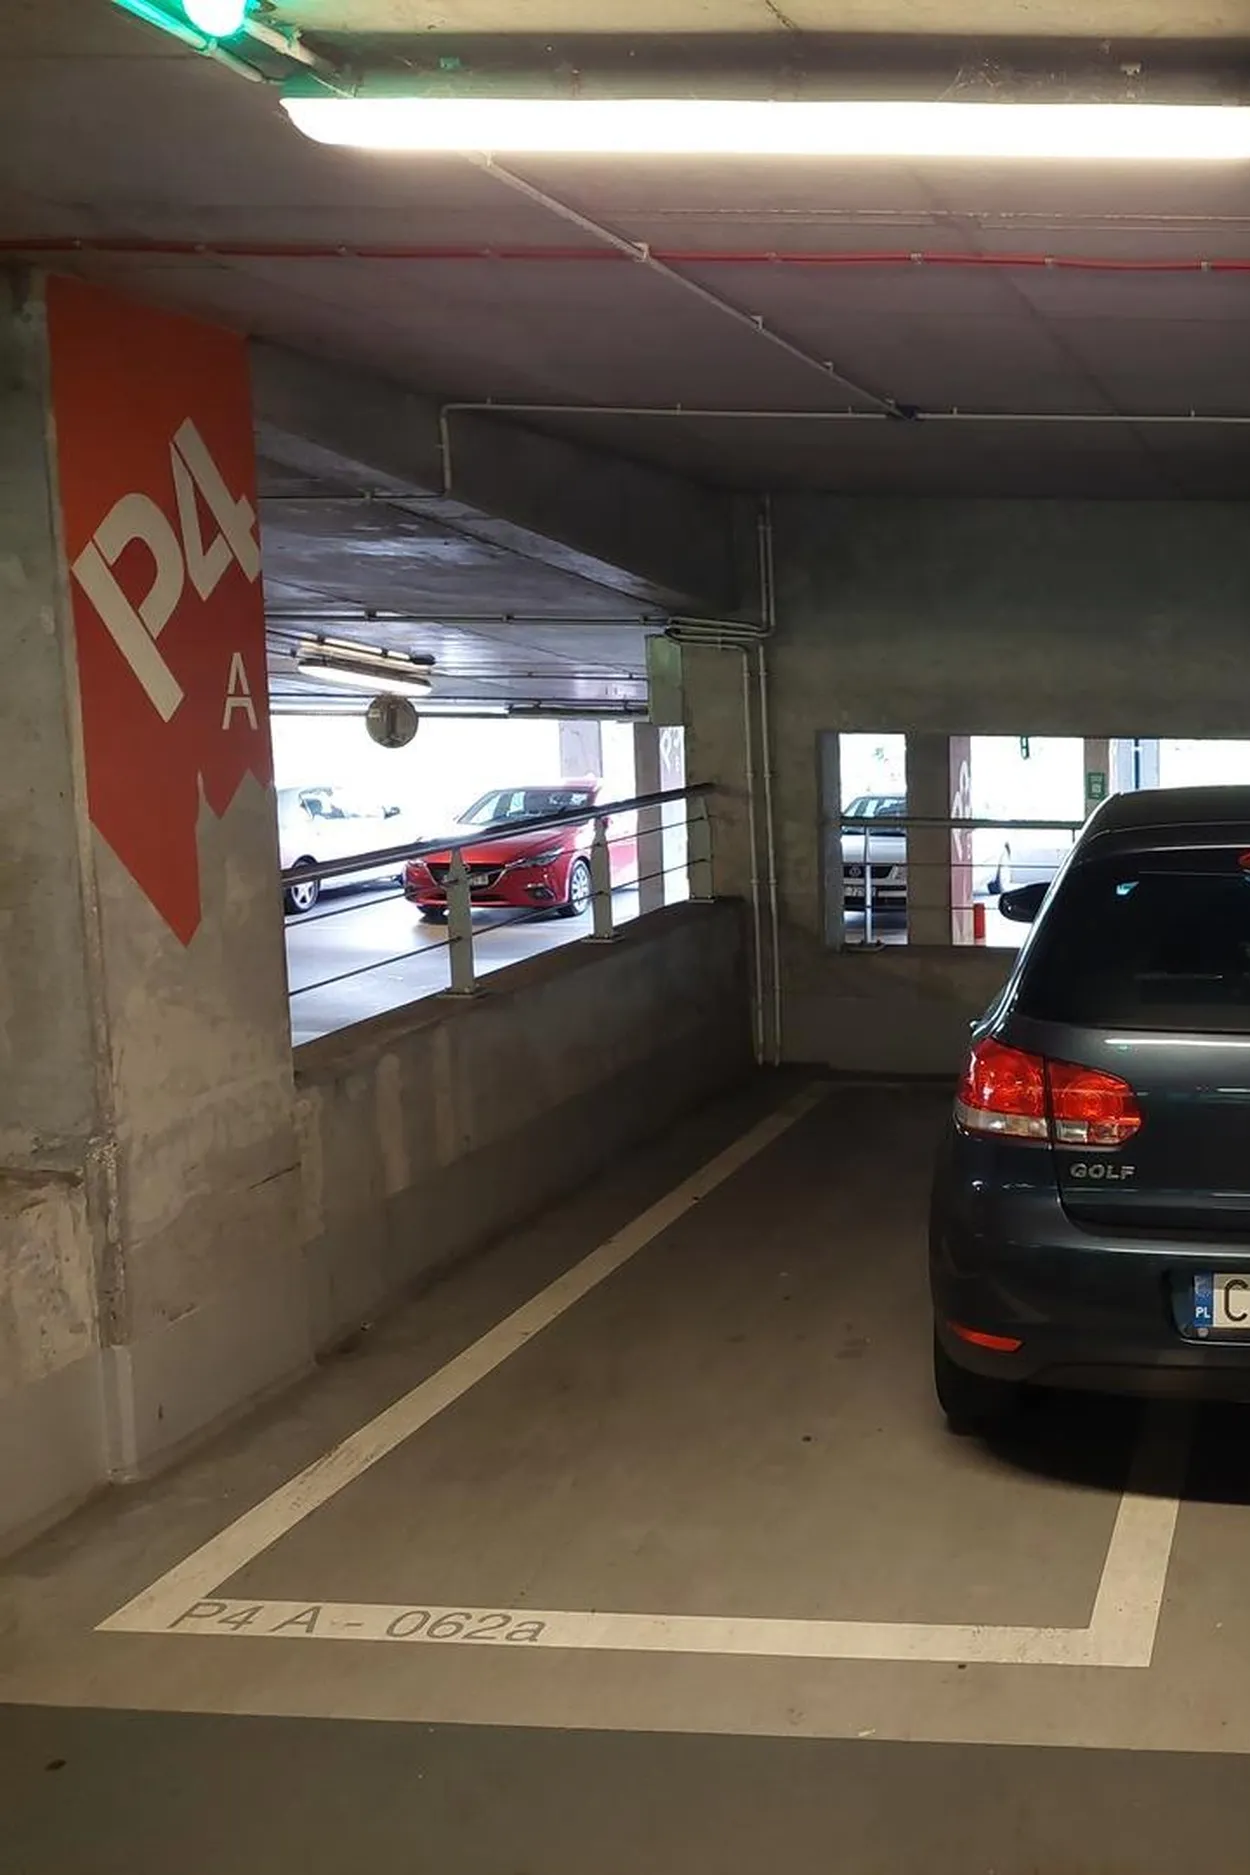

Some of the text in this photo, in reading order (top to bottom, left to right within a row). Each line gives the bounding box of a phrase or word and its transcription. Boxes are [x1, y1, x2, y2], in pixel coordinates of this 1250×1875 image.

[72, 417, 260, 722] P4
[222, 652, 258, 730] A
[1070, 1162, 1136, 1180] GOLF
[1195, 1307, 1212, 1320] PL
[385, 1609, 547, 1643] 062a
